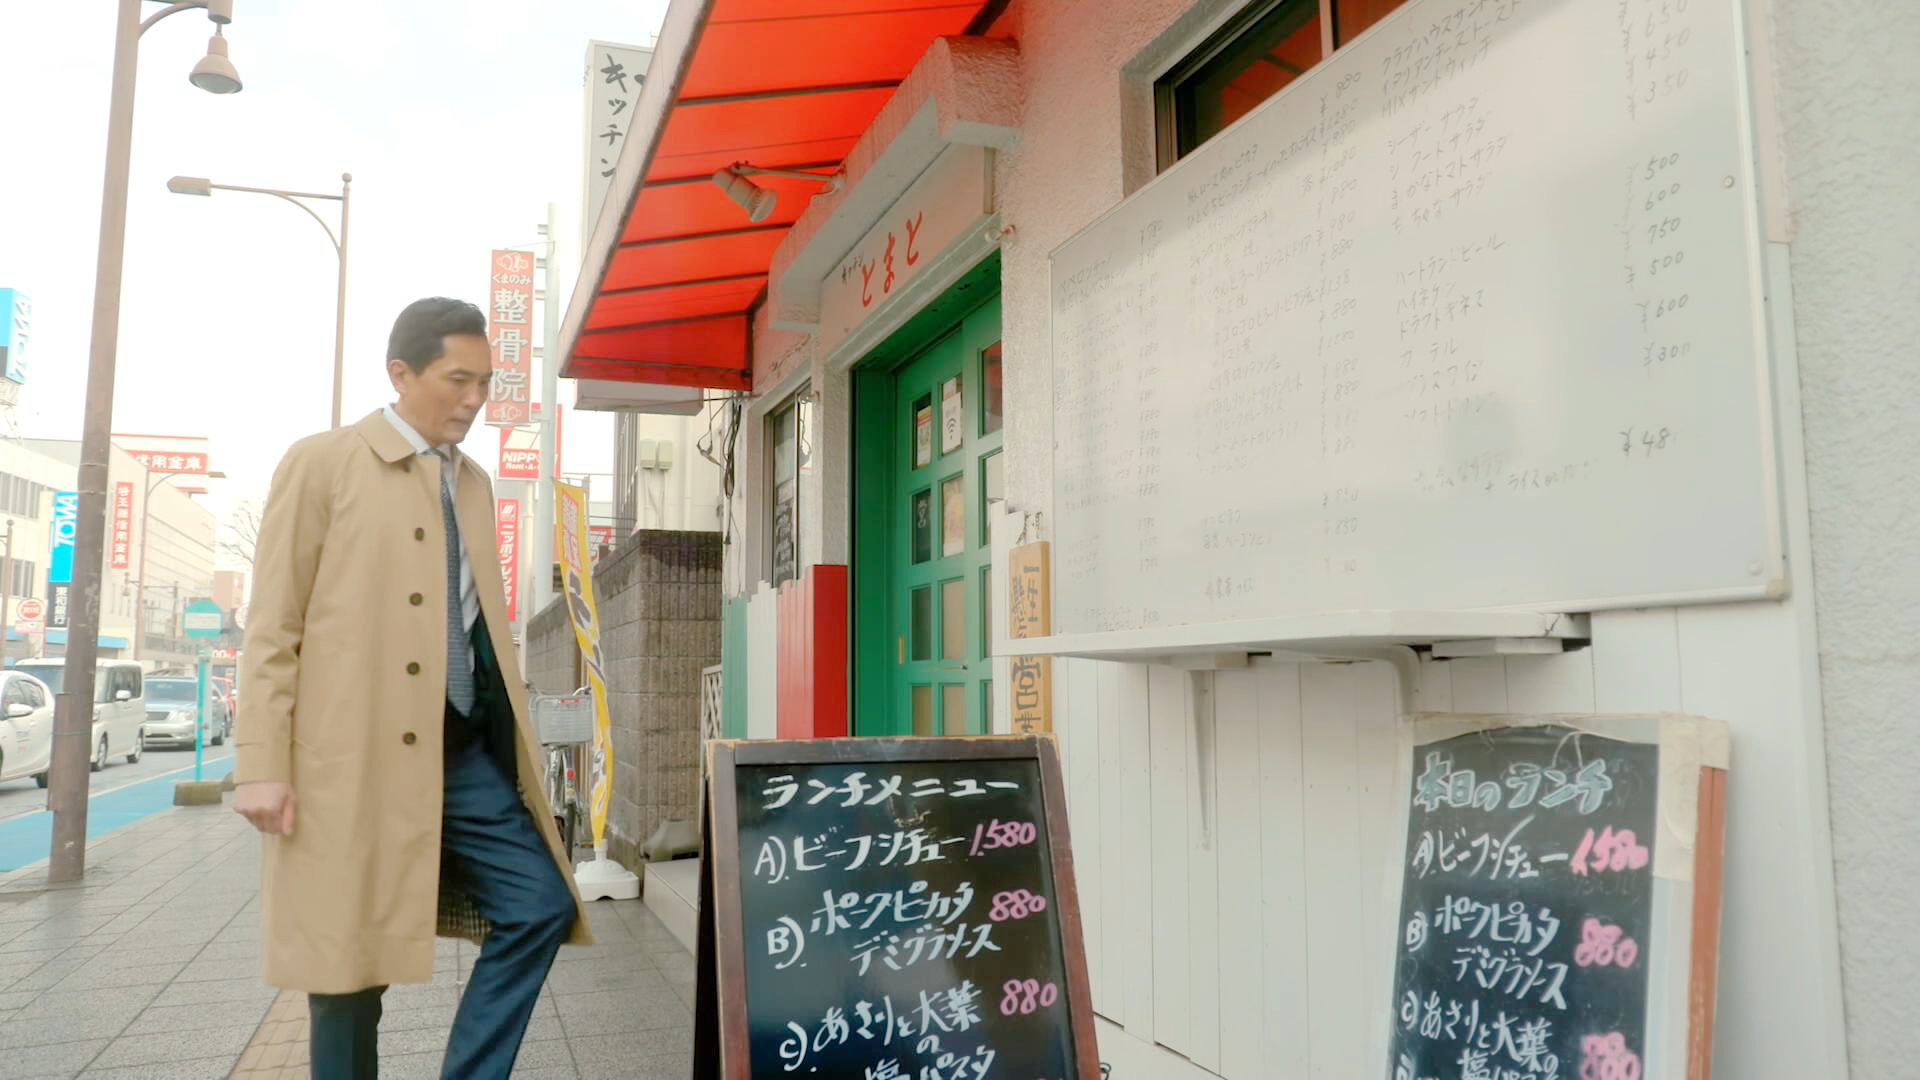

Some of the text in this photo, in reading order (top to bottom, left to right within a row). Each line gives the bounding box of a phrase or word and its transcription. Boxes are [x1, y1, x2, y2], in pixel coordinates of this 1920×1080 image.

[492, 273, 531, 285] くまのみ
[863, 211, 922, 307] とまと
[490, 288, 529, 403] 整骨院
[762, 771, 1019, 810] ランチメニュー
[1414, 751, 1612, 814] 本日のランチ
[793, 826, 966, 872] ビーフシチュー
[810, 880, 1046, 936] ポークピカタ 880
[1434, 895, 1560, 956] ポークピカタ
[849, 922, 1002, 976] デミグラソース
[1000, 979, 1058, 1017] 880
